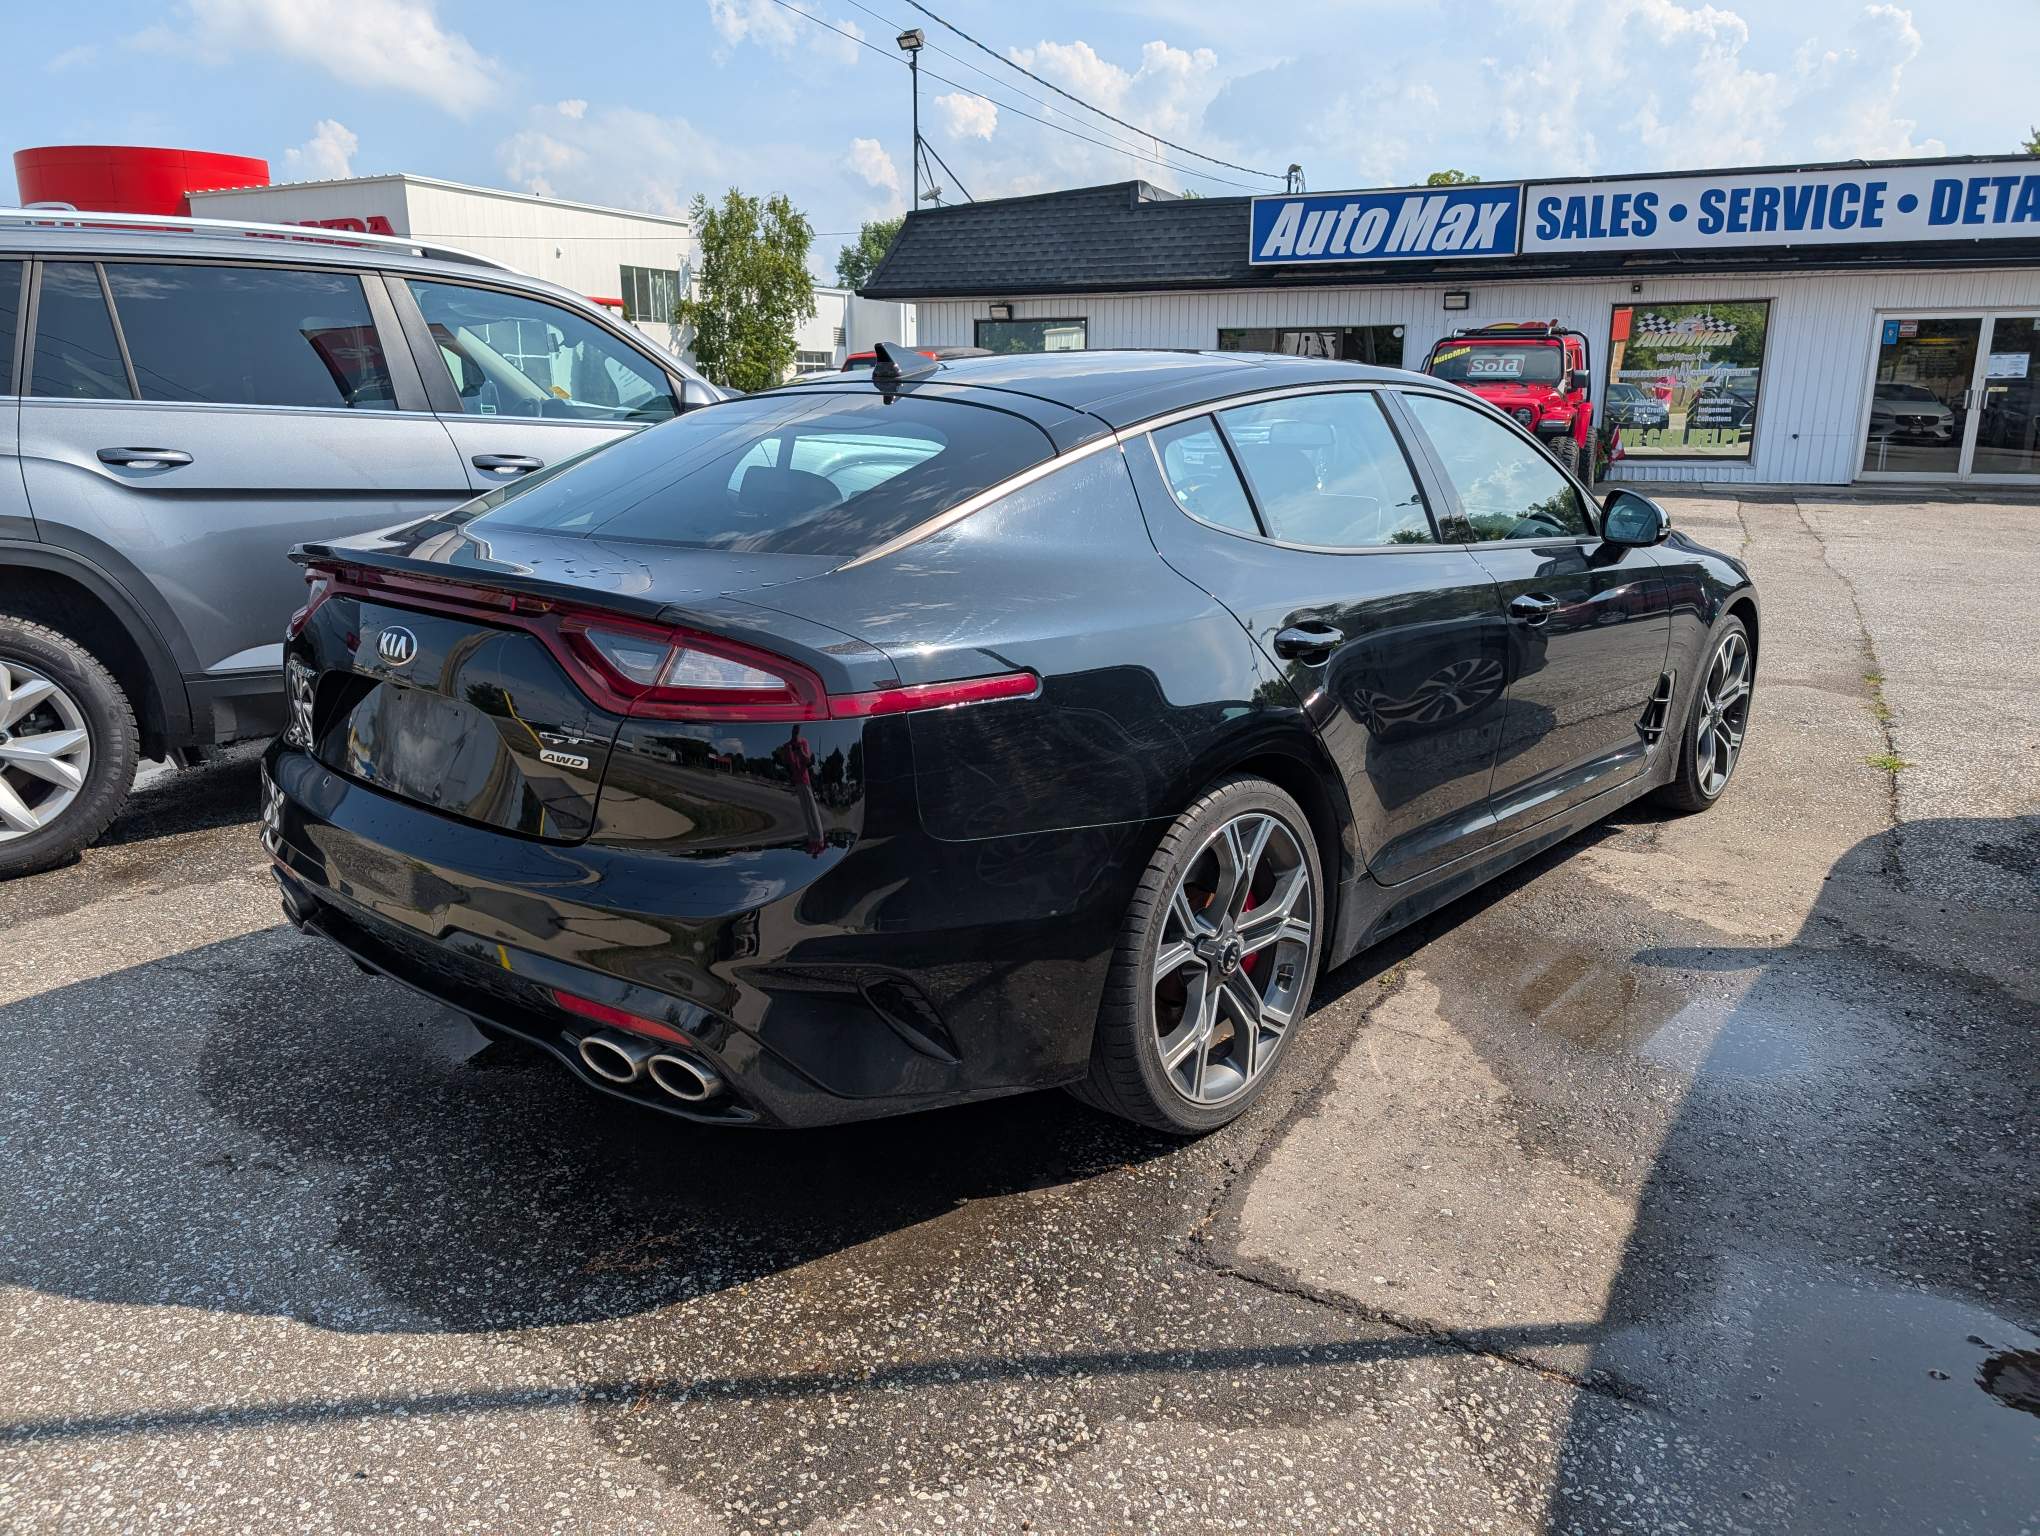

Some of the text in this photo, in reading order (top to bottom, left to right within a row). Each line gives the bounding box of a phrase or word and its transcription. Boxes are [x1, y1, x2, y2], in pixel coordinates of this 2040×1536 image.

[1535, 174, 2040, 241] SALES SERVICE DETA
[1433, 345, 1471, 365] AutoMax
[1472, 359, 1519, 372] Sold
[380, 632, 407, 659] KIA
[543, 754, 584, 766] AWD
